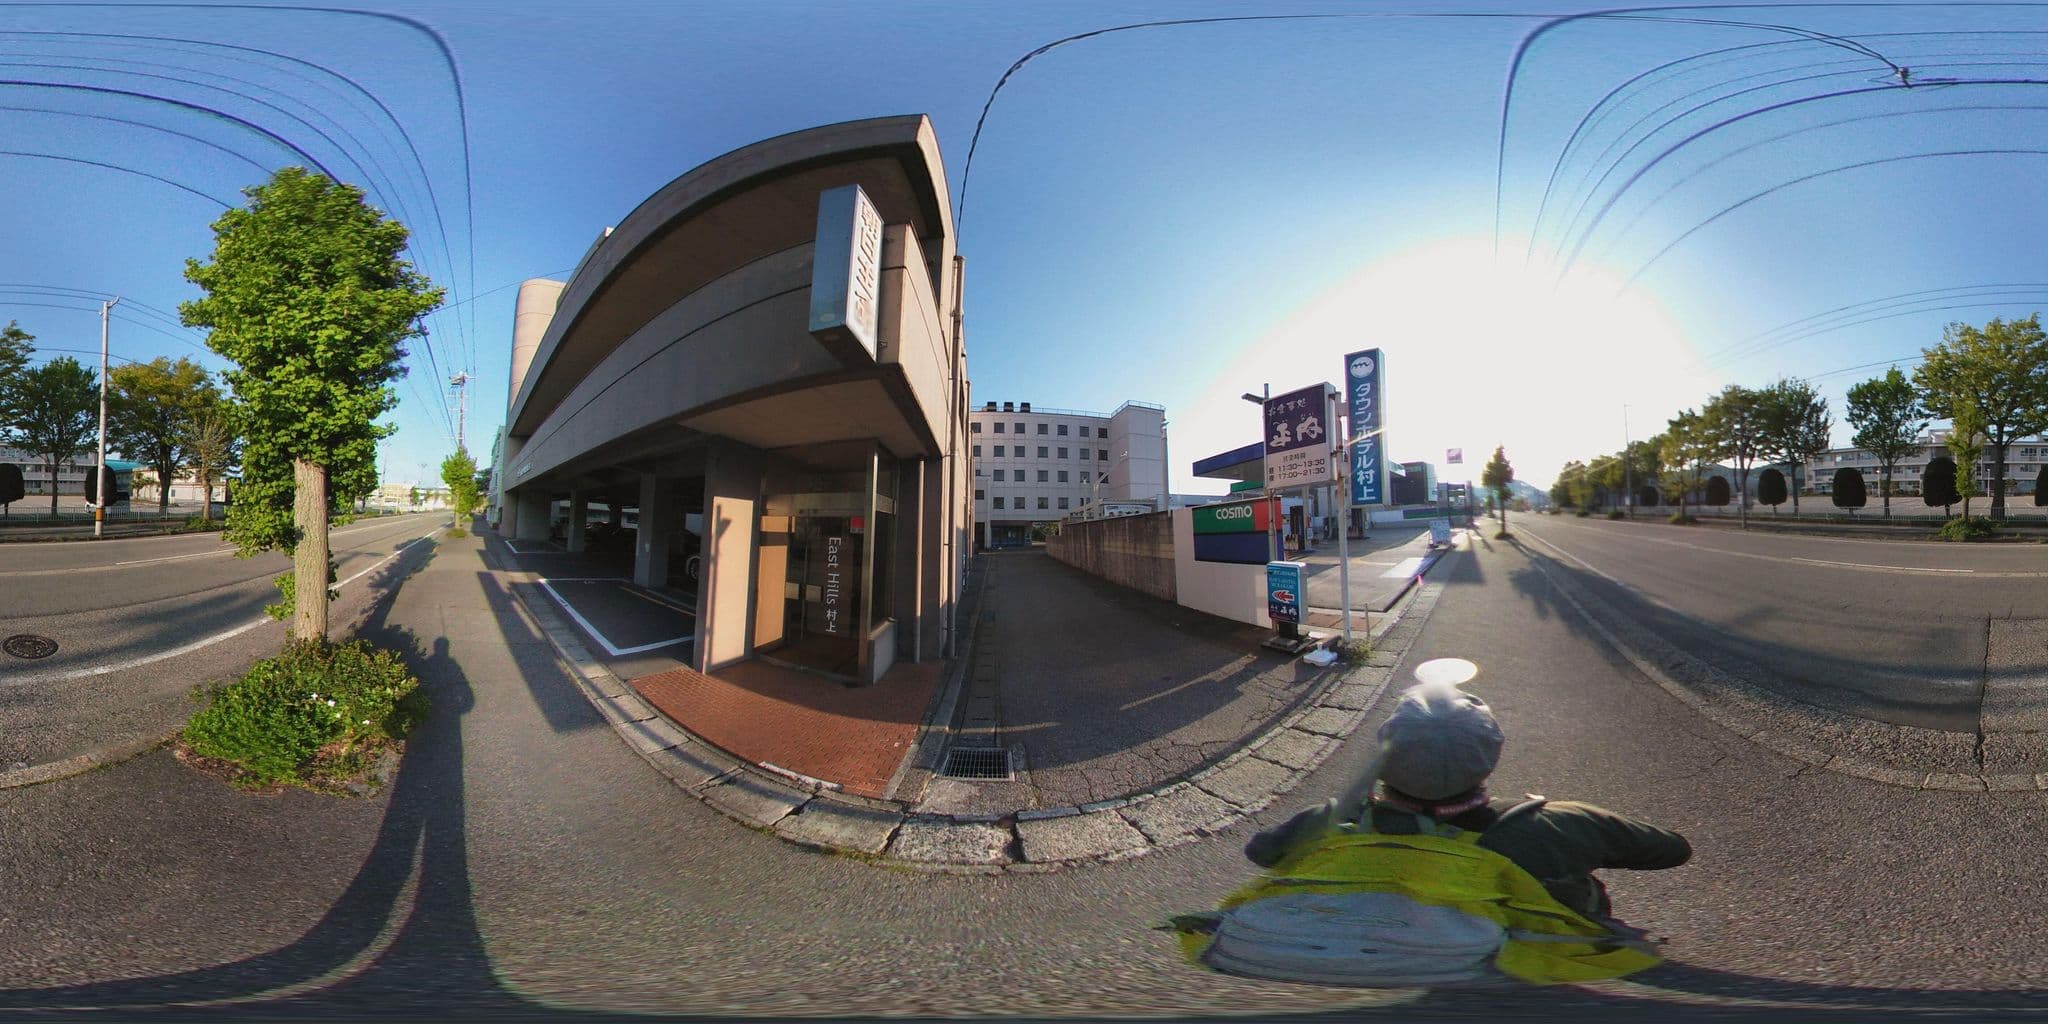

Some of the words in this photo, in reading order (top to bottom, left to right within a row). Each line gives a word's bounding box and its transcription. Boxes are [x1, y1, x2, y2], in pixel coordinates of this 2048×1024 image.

[1355, 382, 1376, 501] タウンホテル村上
[1215, 505, 1253, 520] COSMO
[827, 537, 842, 568] East
[826, 573, 841, 605] Hills
[825, 608, 838, 633] 村上
